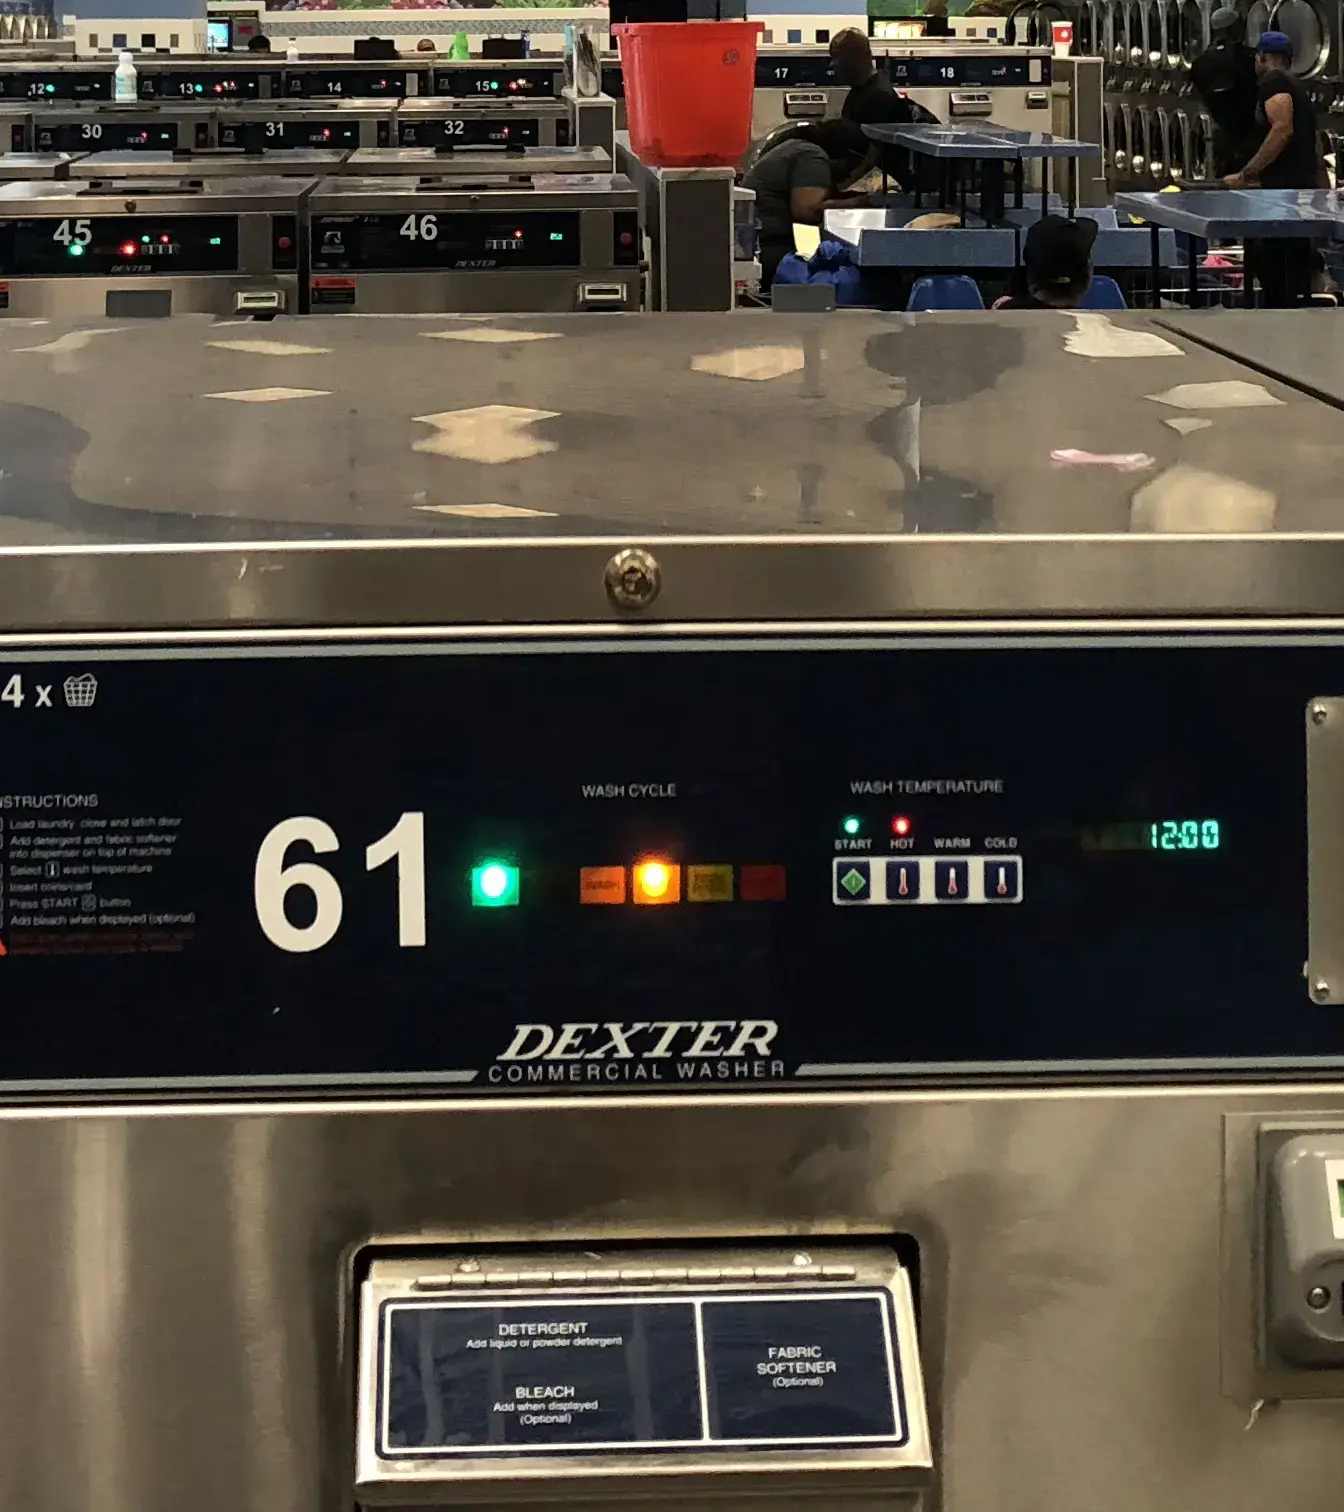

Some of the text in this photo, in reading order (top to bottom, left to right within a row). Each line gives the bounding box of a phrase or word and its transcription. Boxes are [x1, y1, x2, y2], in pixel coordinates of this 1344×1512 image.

[773, 67, 790, 79] 17
[939, 67, 955, 79] 18
[179, 82, 194, 94] 13
[327, 81, 342, 93] 14
[474, 79, 490, 92] 15
[81, 124, 102, 139] 30
[265, 121, 285, 137] 31
[443, 120, 465, 135] 32
[52, 219, 92, 246] 45
[399, 214, 438, 241] 46
[0, 673, 53, 709] 4 x
[581, 782, 677, 798] WASH CYCLE
[850, 779, 1004, 795] WASH TEMPERATURE
[1151, 819, 1220, 850] 12:00
[834, 837, 1018, 850] START HOT WARM COLD
[254, 811, 426, 953] 61
[495, 1019, 779, 1061] DEXTER
[488, 1060, 785, 1083] COMMERCIAL WASHER
[498, 1322, 589, 1337] DETERGENT
[466, 1336, 623, 1350] Add liquid or powder detergent
[768, 1345, 822, 1359] FABRIC
[756, 1360, 837, 1376] SOFTENER
[772, 1376, 824, 1388] (Optional)
[515, 1385, 576, 1399] BLEACH
[492, 1400, 599, 1412] Add when displayed
[519, 1413, 572, 1426] (Optional)
